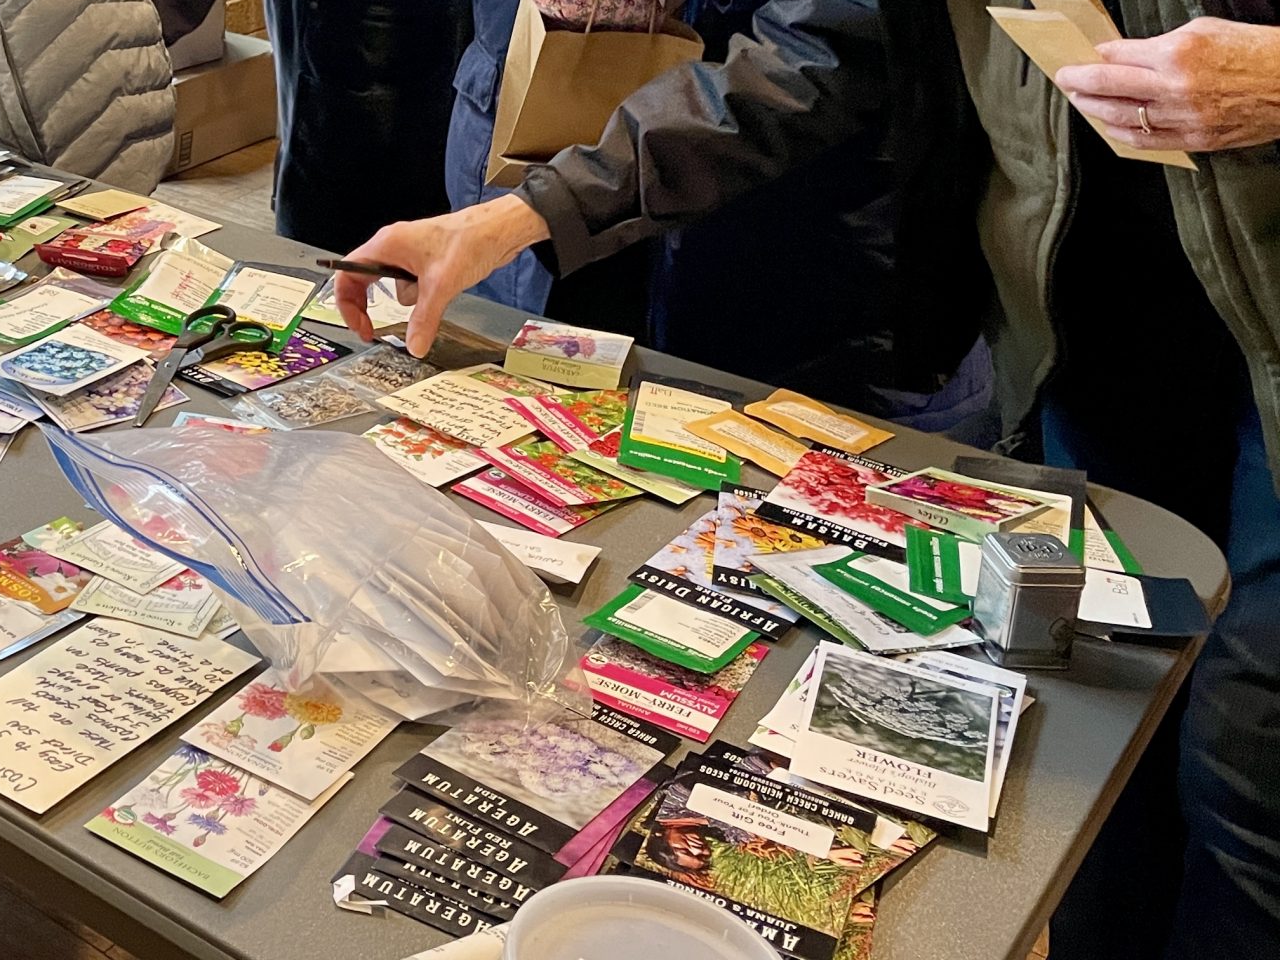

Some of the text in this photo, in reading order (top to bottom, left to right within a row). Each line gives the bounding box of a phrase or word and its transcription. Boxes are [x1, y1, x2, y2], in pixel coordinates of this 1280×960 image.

[439, 419, 473, 433] April
[478, 422, 501, 436] Very
[512, 420, 527, 428] on
[534, 496, 577, 522] CARDINAL
[915, 507, 949, 525] Aster
[790, 515, 867, 548] BALSAM
[815, 517, 888, 547] PEPPERMINT
[635, 569, 689, 597] DAISY
[716, 571, 758, 590] AISY
[694, 584, 733, 603] FLAKE
[101, 603, 175, 626] Renee's Garden
[695, 592, 779, 632] AFRICAN
[86, 621, 120, 640] bloom
[65, 644, 89, 658] can
[124, 637, 144, 650] in
[89, 636, 213, 696] have as many as
[92, 656, 143, 680] plants
[156, 637, 233, 677] at a time.
[74, 661, 113, 684] These
[202, 671, 225, 685] 20
[33, 674, 73, 696] with
[46, 663, 169, 723] yellow or orange
[615, 698, 651, 716] ANNUAL
[659, 688, 717, 715] ALYSSUM
[5, 695, 115, 751] These are tall
[5, 717, 33, 736] sow
[116, 712, 149, 729] 3-4
[597, 713, 627, 729] CREEK
[12, 738, 28, 753] to
[628, 726, 657, 743] BAKER
[34, 746, 76, 774] Easy
[846, 756, 936, 788] Bishop's Flower
[854, 748, 932, 778] FLOWER
[472, 784, 507, 806] LEDA
[698, 763, 854, 823] BAKER CREEK HEIRLOOM SEEDS
[817, 765, 926, 805] Seed Savers
[421, 770, 538, 838] AGERATUM
[711, 795, 734, 809] Your
[735, 804, 752, 815] For
[746, 801, 780, 819] Order!
[443, 810, 512, 849] RED FLINT
[729, 810, 785, 836] Free Gift
[111, 826, 161, 856] BUTTON
[407, 805, 527, 874] AGERATUM
[403, 838, 529, 901] AGERATUM
[361, 871, 491, 934] AGERATUM
[664, 878, 797, 933] JUANA'S ORANGE
